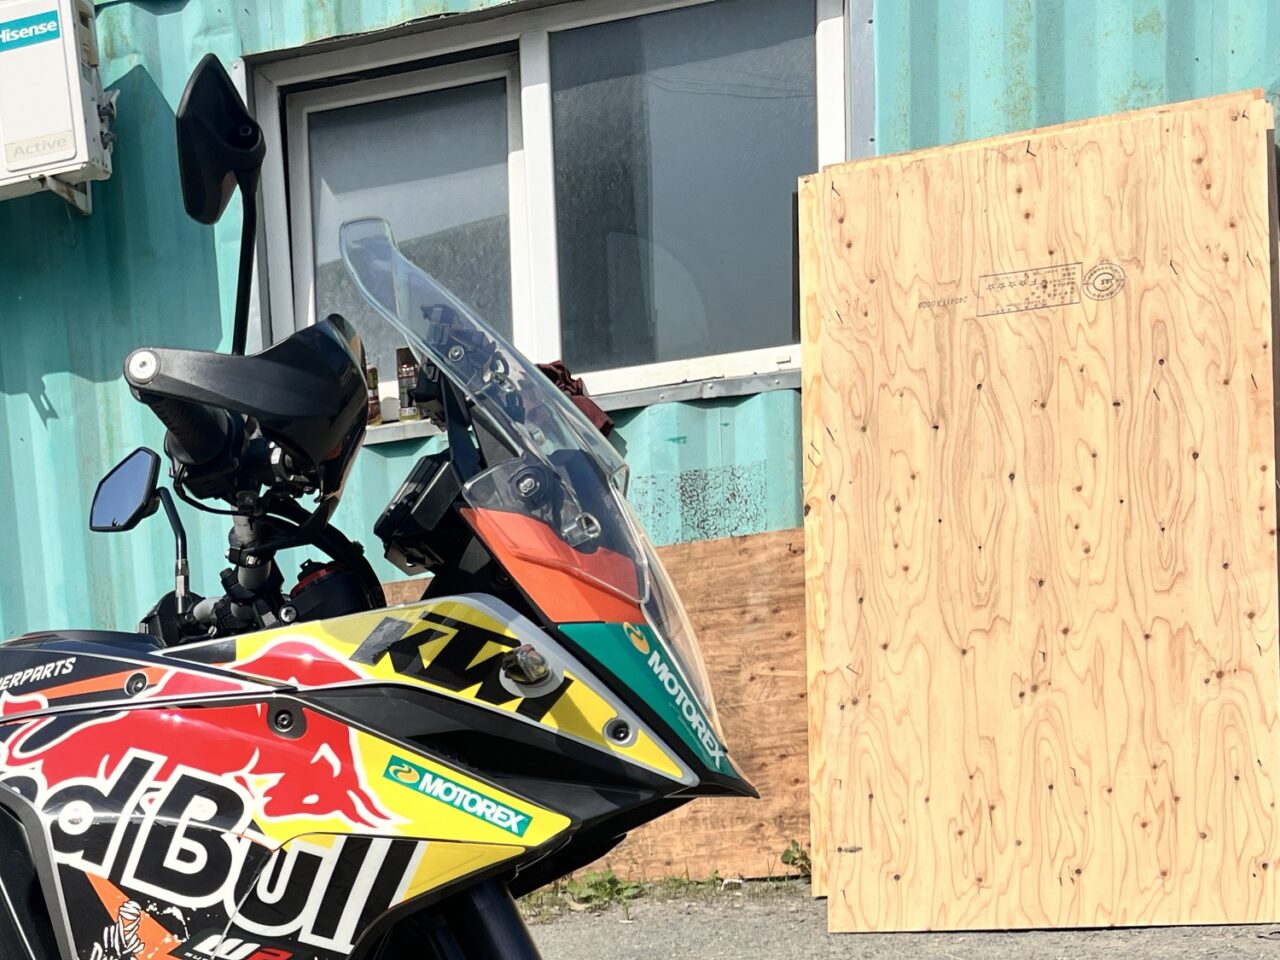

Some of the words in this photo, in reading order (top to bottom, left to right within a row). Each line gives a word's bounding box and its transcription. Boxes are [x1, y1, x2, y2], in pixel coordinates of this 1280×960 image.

[12, 136, 67, 158] Active
[348, 612, 574, 723] KTM
[647, 648, 726, 767] MOTOREX
[120, 763, 424, 954] Bull
[418, 773, 527, 836] MOTOREX
